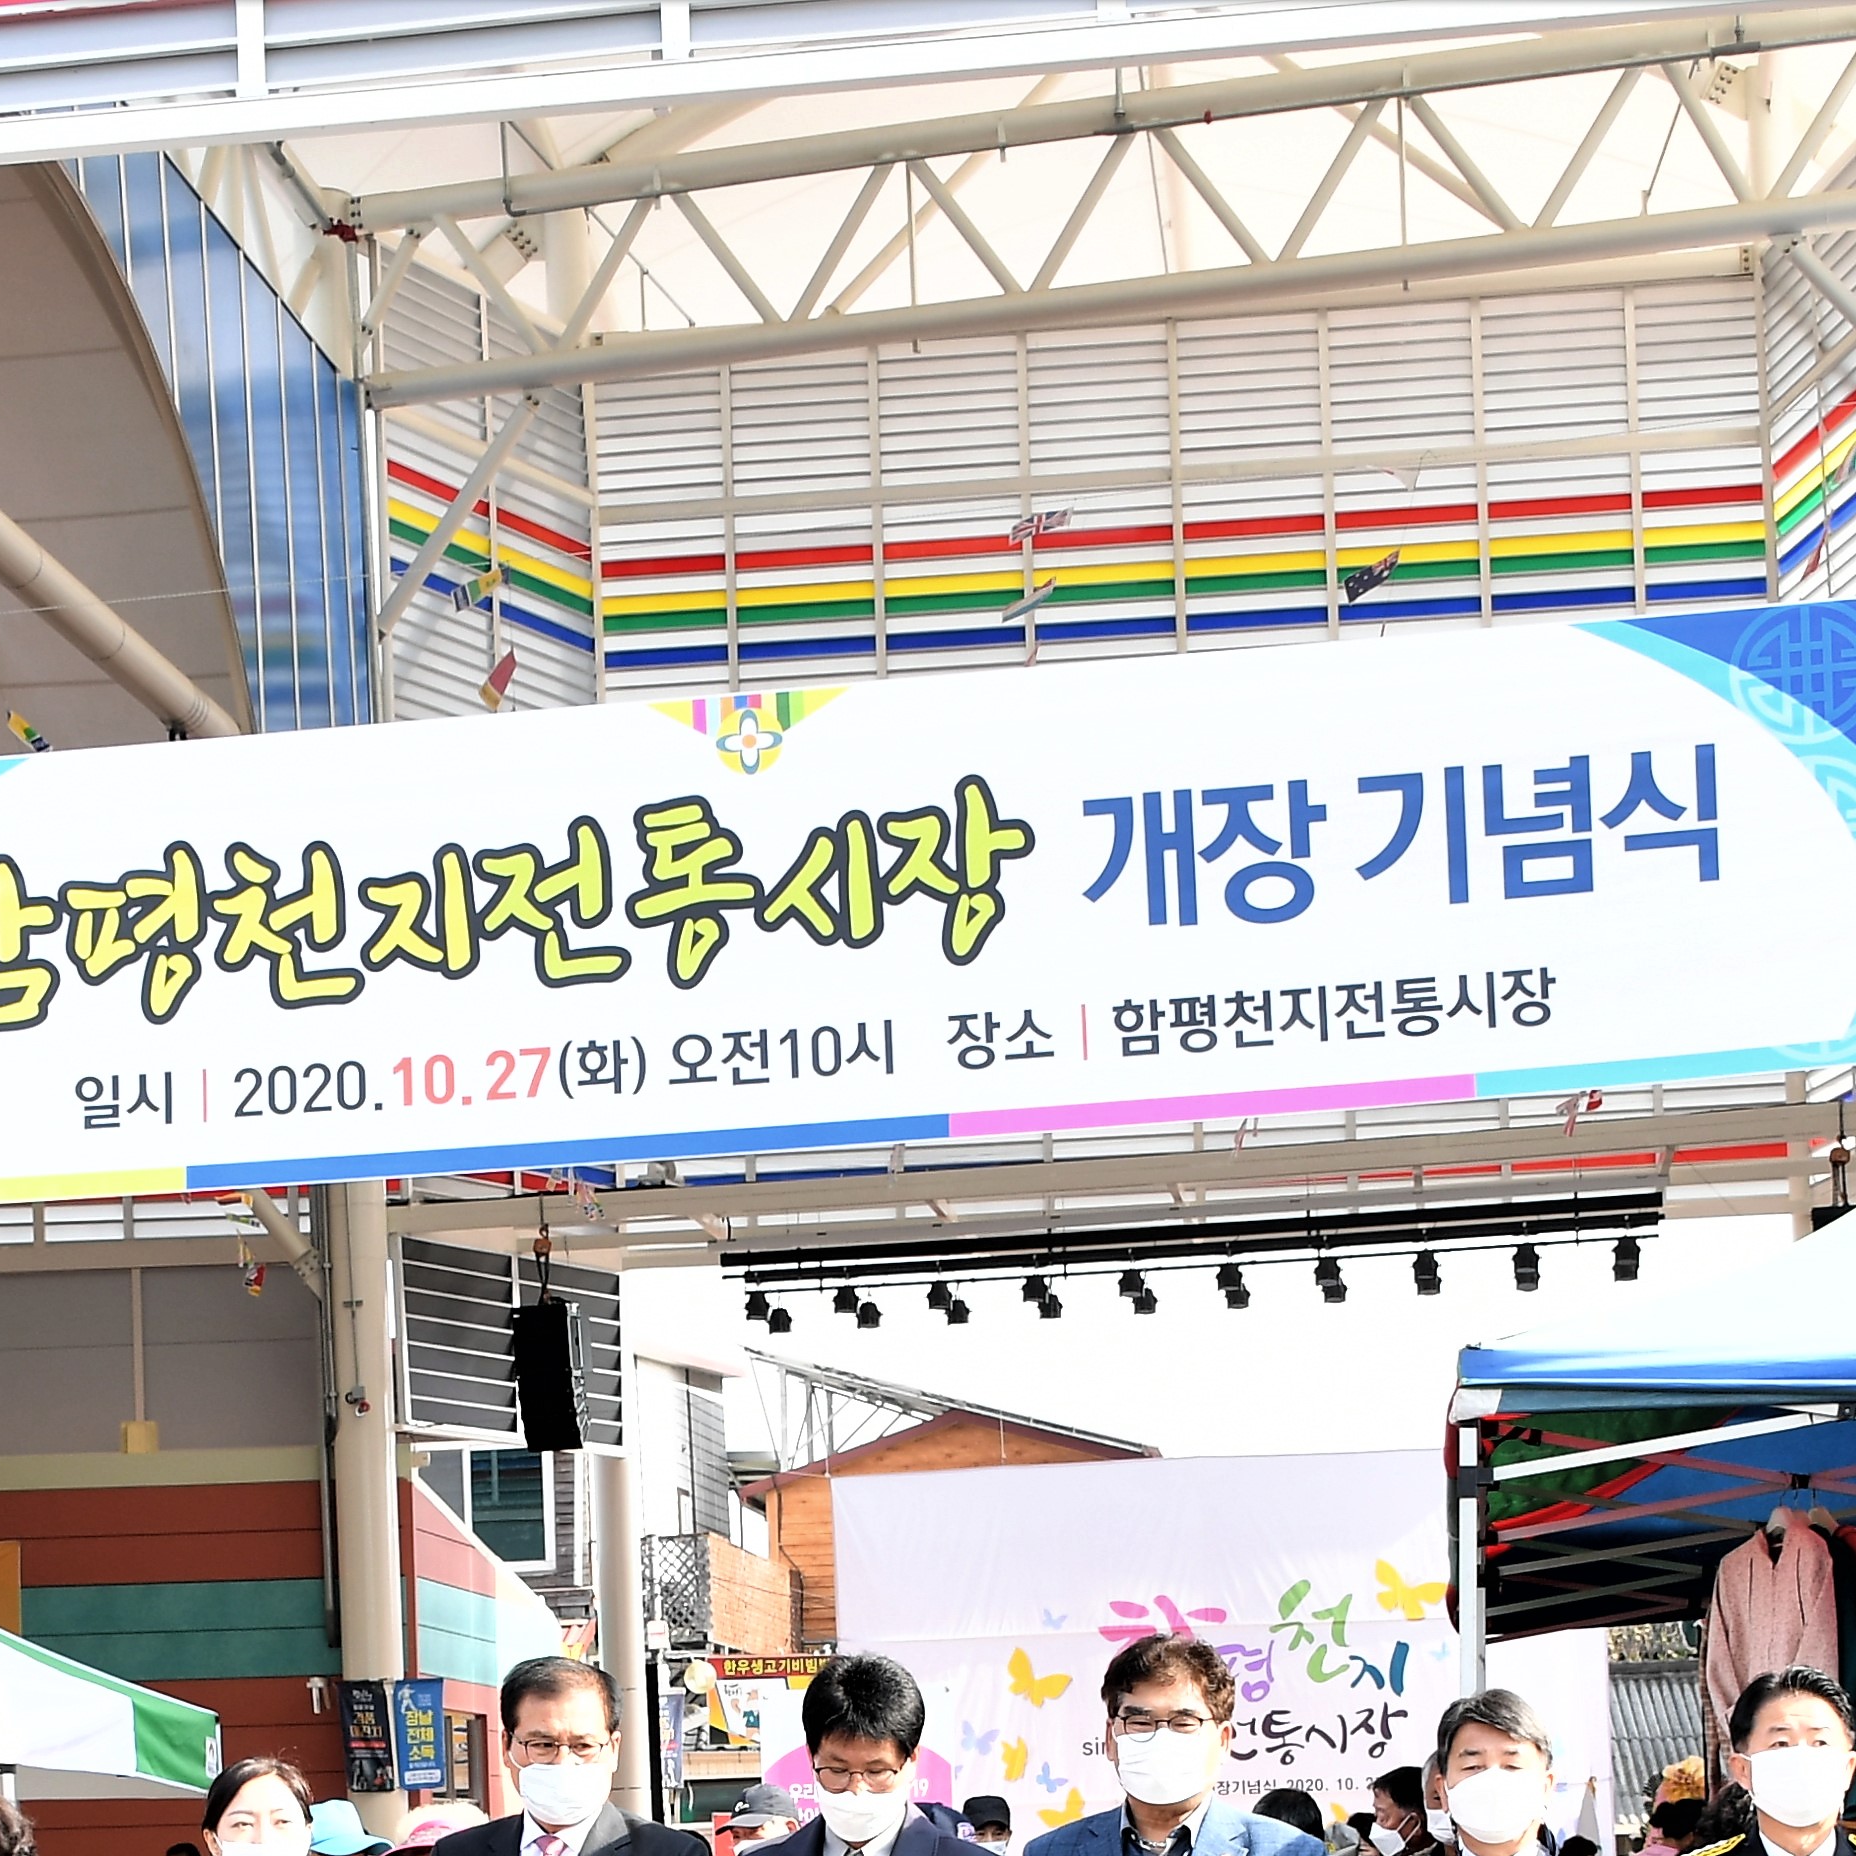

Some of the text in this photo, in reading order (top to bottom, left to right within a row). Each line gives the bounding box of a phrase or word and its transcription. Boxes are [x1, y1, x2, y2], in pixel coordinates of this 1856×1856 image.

[1082, 778, 1327, 926] 개장
[1355, 743, 1720, 904] 기념식
[73, 1072, 174, 1130] 일시
[668, 1019, 896, 1087] 오전10시
[946, 1009, 1055, 1070] 장소
[1111, 966, 1557, 1058] 함평천지전통시장
[1212, 1778, 1277, 1796] 장기념식
